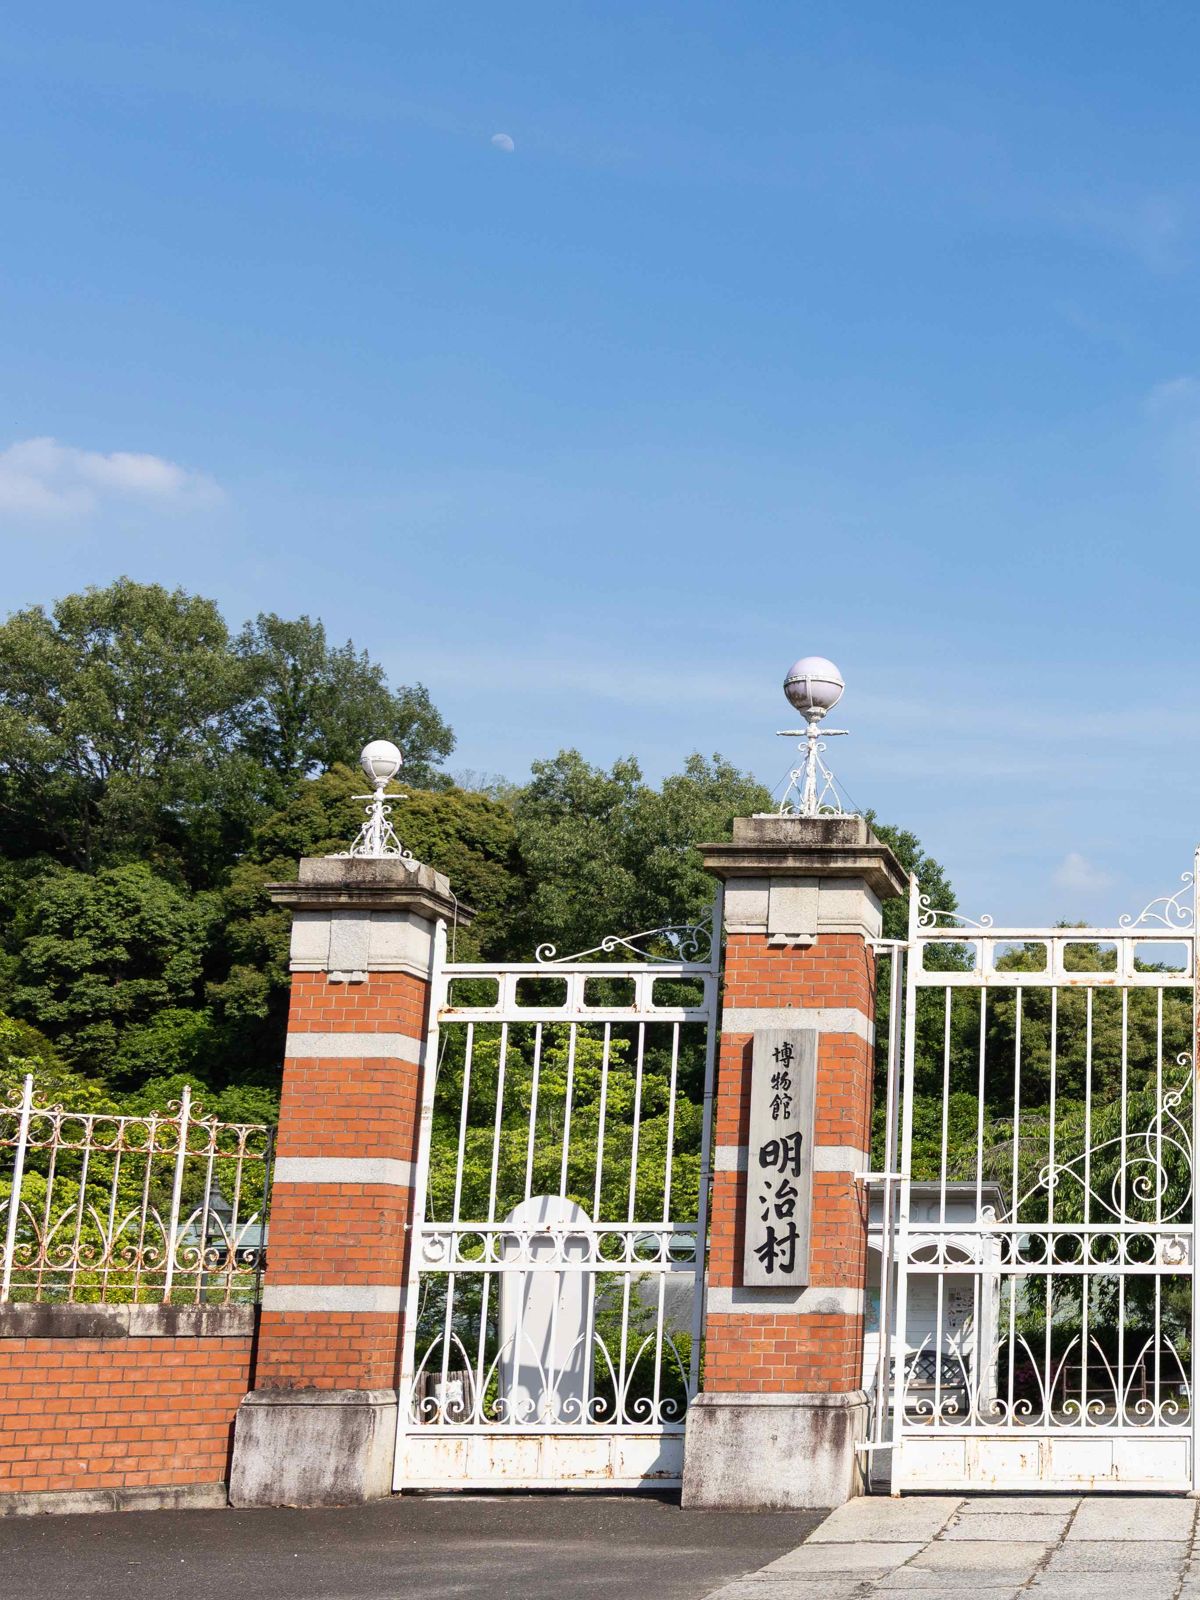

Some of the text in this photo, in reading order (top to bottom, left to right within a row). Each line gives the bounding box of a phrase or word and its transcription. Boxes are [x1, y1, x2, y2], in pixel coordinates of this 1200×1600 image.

[753, 1042, 803, 1274] 博物館 明治村
